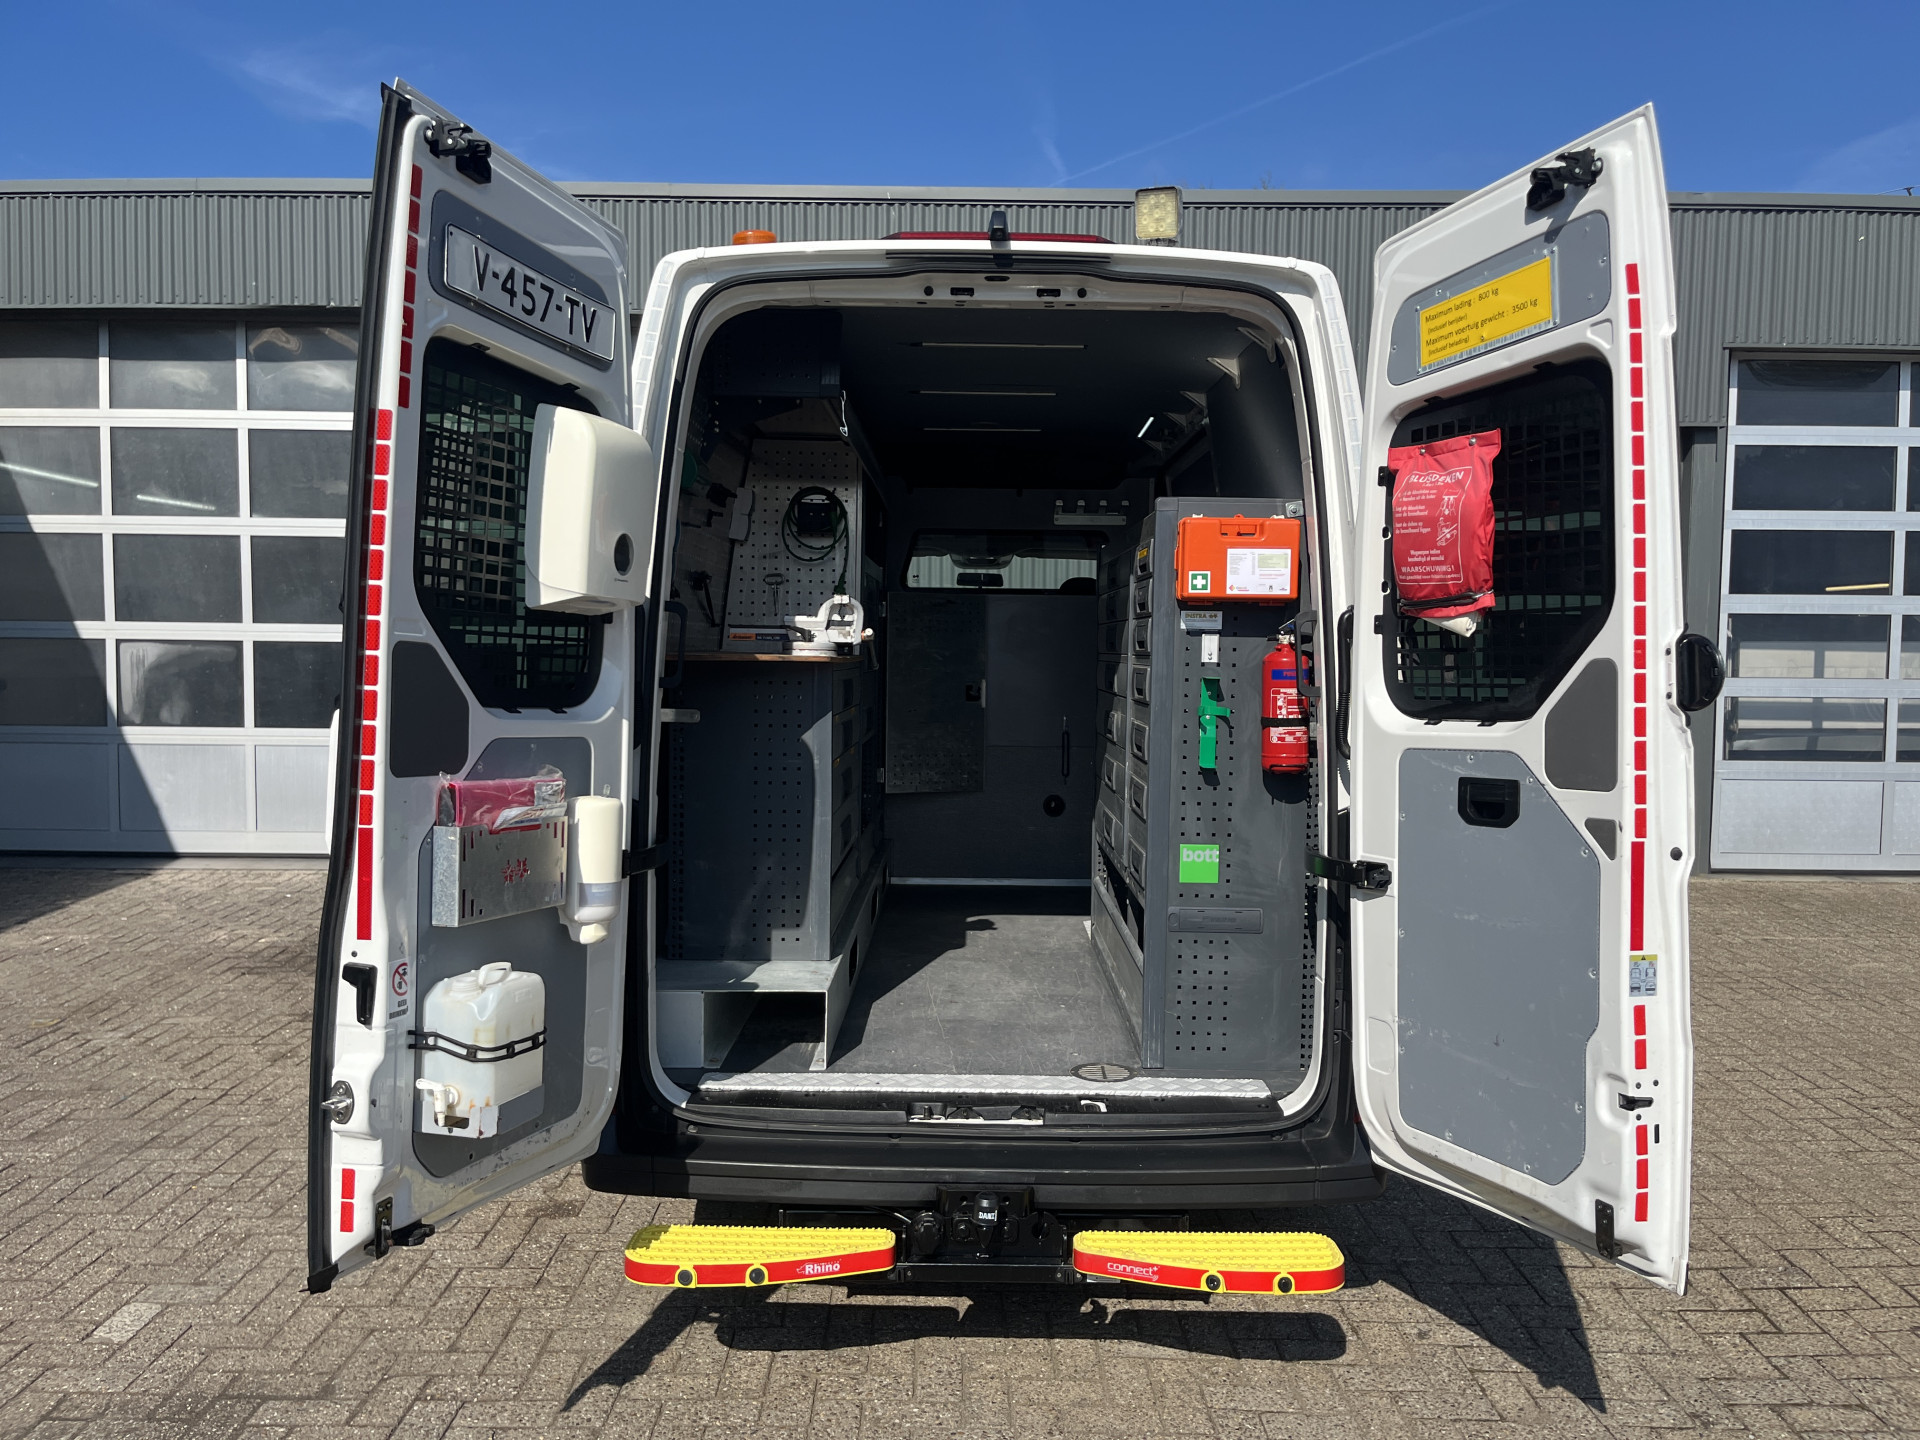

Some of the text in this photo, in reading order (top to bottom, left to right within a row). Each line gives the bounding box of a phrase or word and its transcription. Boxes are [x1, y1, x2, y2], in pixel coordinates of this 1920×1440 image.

[473, 245, 597, 343] V-457-TV
[1425, 307, 1453, 323] Maximum
[1453, 299, 1472, 311] lading
[1478, 290, 1490, 301] 800
[1491, 288, 1499, 297] kg
[1426, 331, 1454, 347] Maximum
[1454, 321, 1480, 336] voertuig
[1480, 311, 1505, 328] gewicht
[1511, 301, 1529, 314] 3500
[1529, 298, 1538, 308] kg
[1182, 847, 1219, 863] bott
[805, 1262, 841, 1275] Rhino
